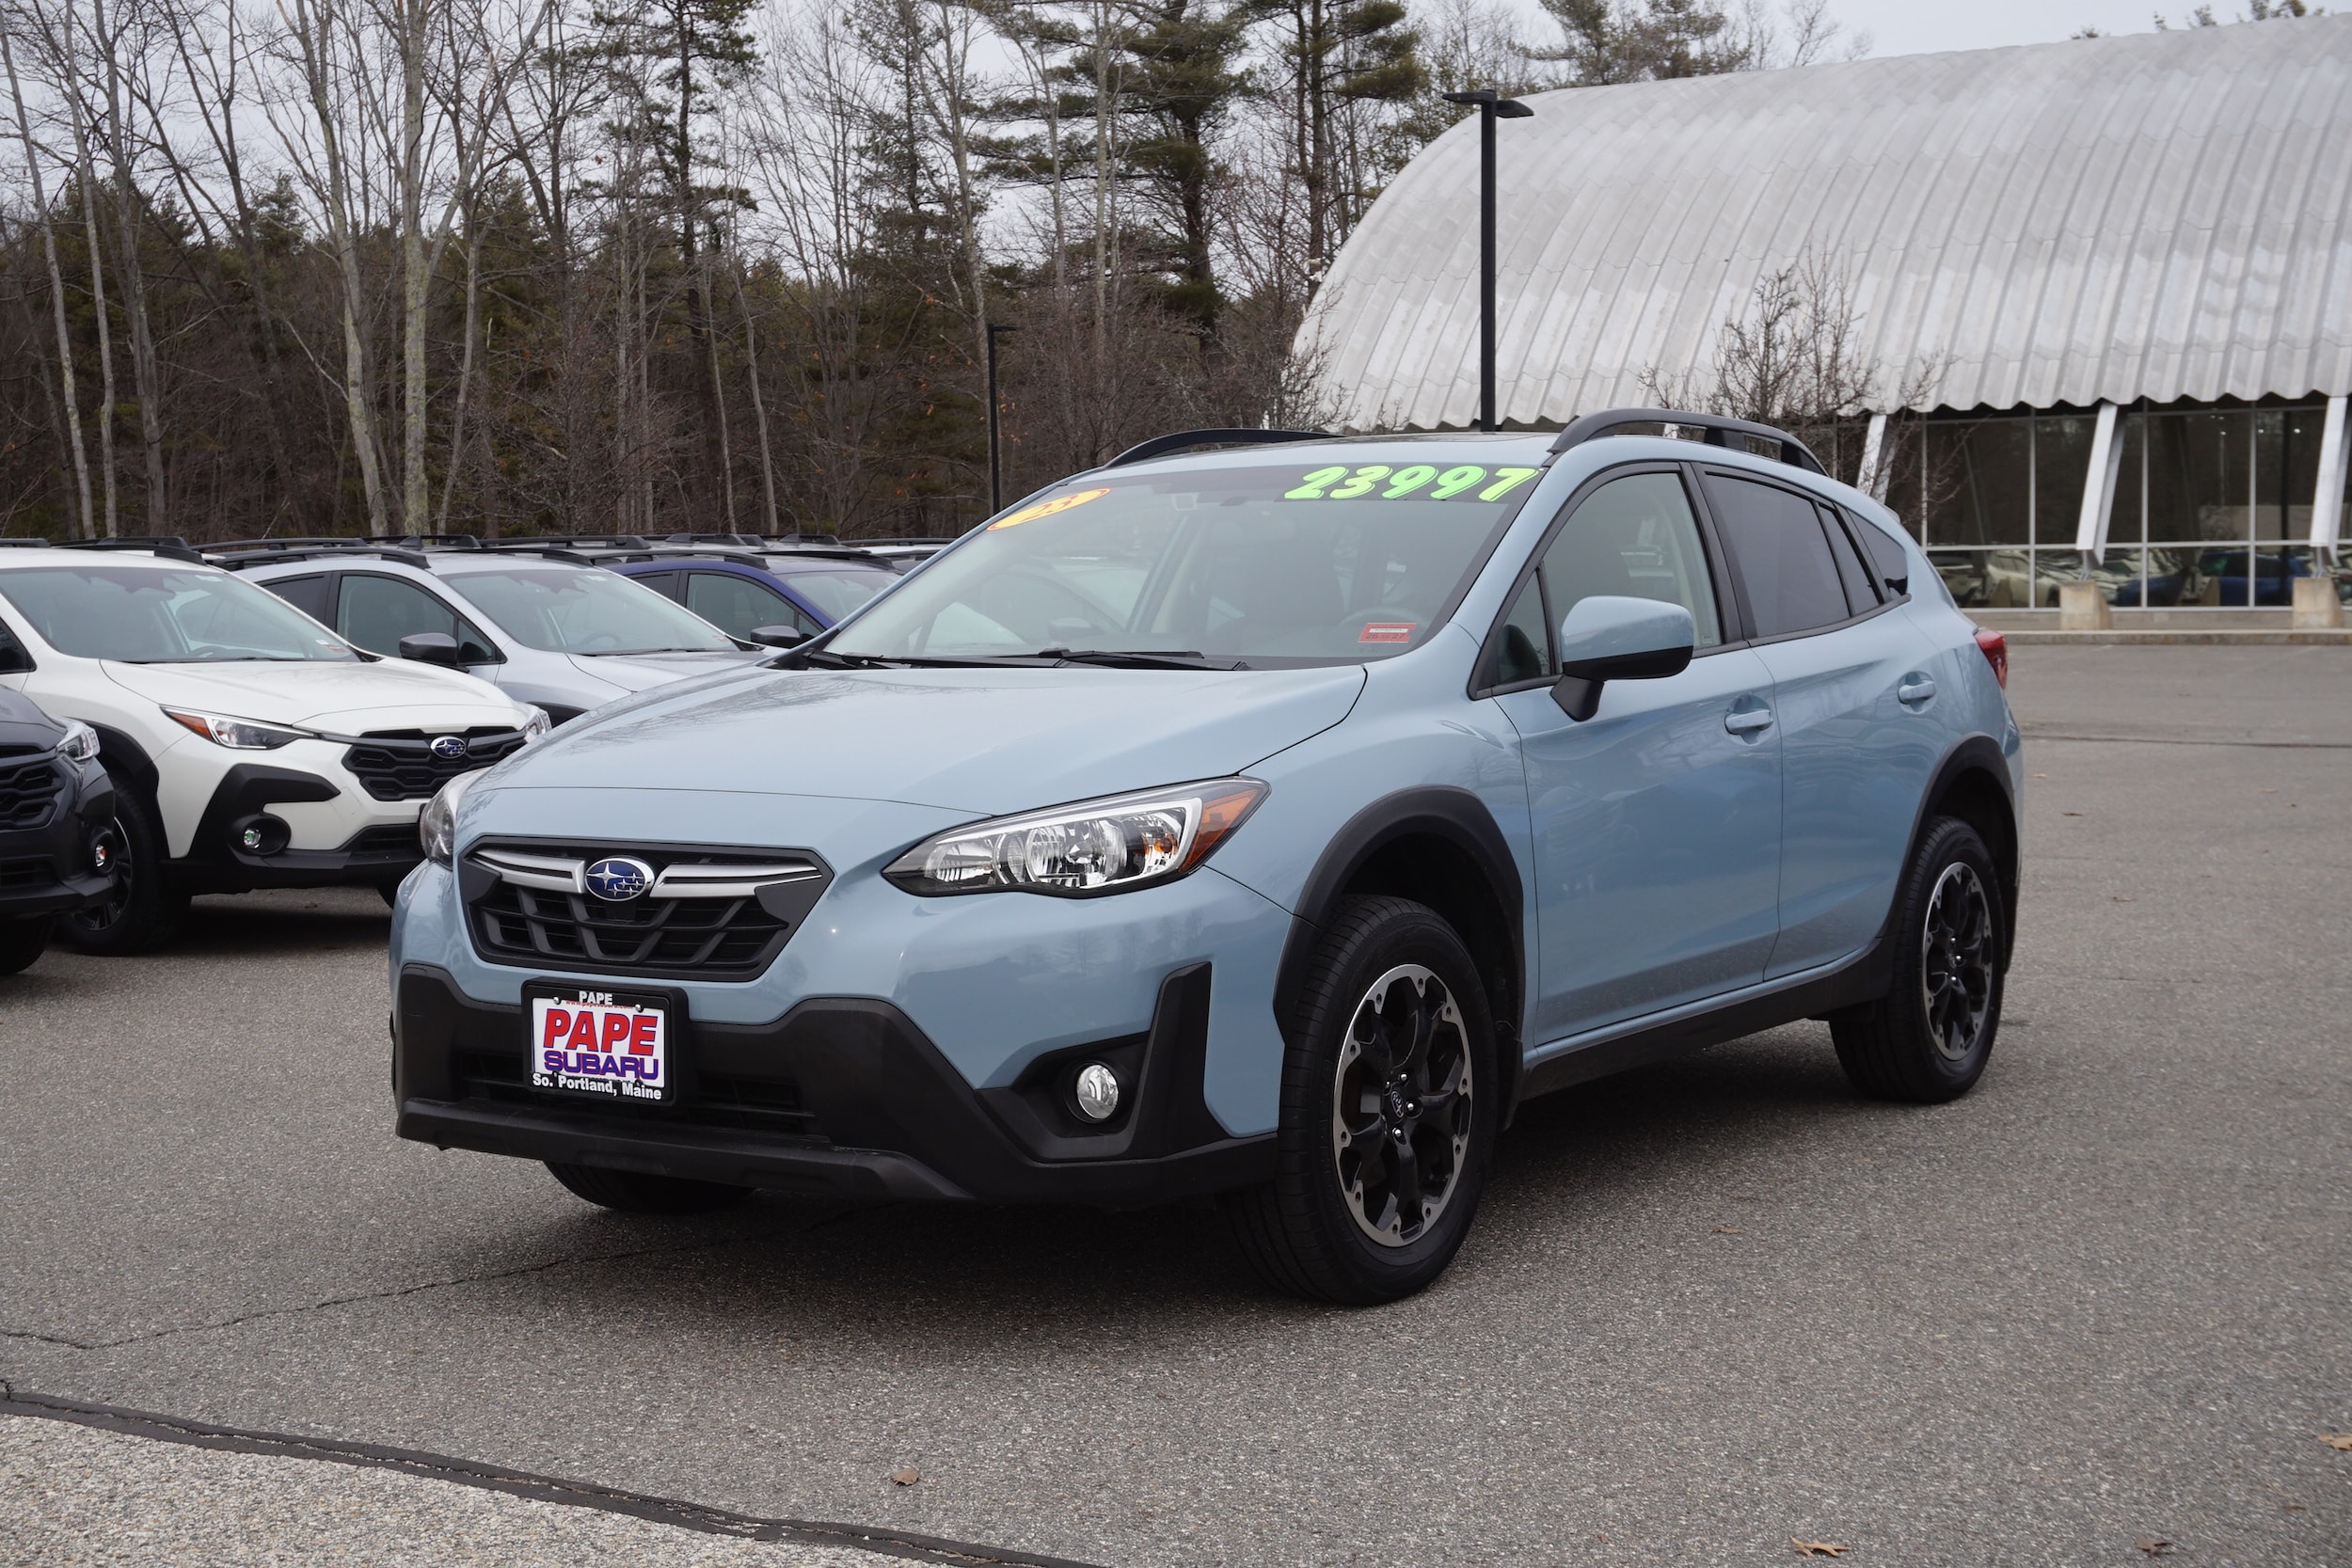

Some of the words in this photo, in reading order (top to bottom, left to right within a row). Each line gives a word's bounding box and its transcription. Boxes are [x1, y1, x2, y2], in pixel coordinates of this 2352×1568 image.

[1284, 465, 1538, 501] 23997
[1020, 495, 1079, 522] 23
[579, 990, 613, 1006] PAPE
[543, 1008, 659, 1056] PAPE
[544, 1050, 659, 1081] SUBARU
[532, 1072, 553, 1087] So.
[557, 1074, 617, 1097] Portland,
[622, 1082, 662, 1101] Maine
